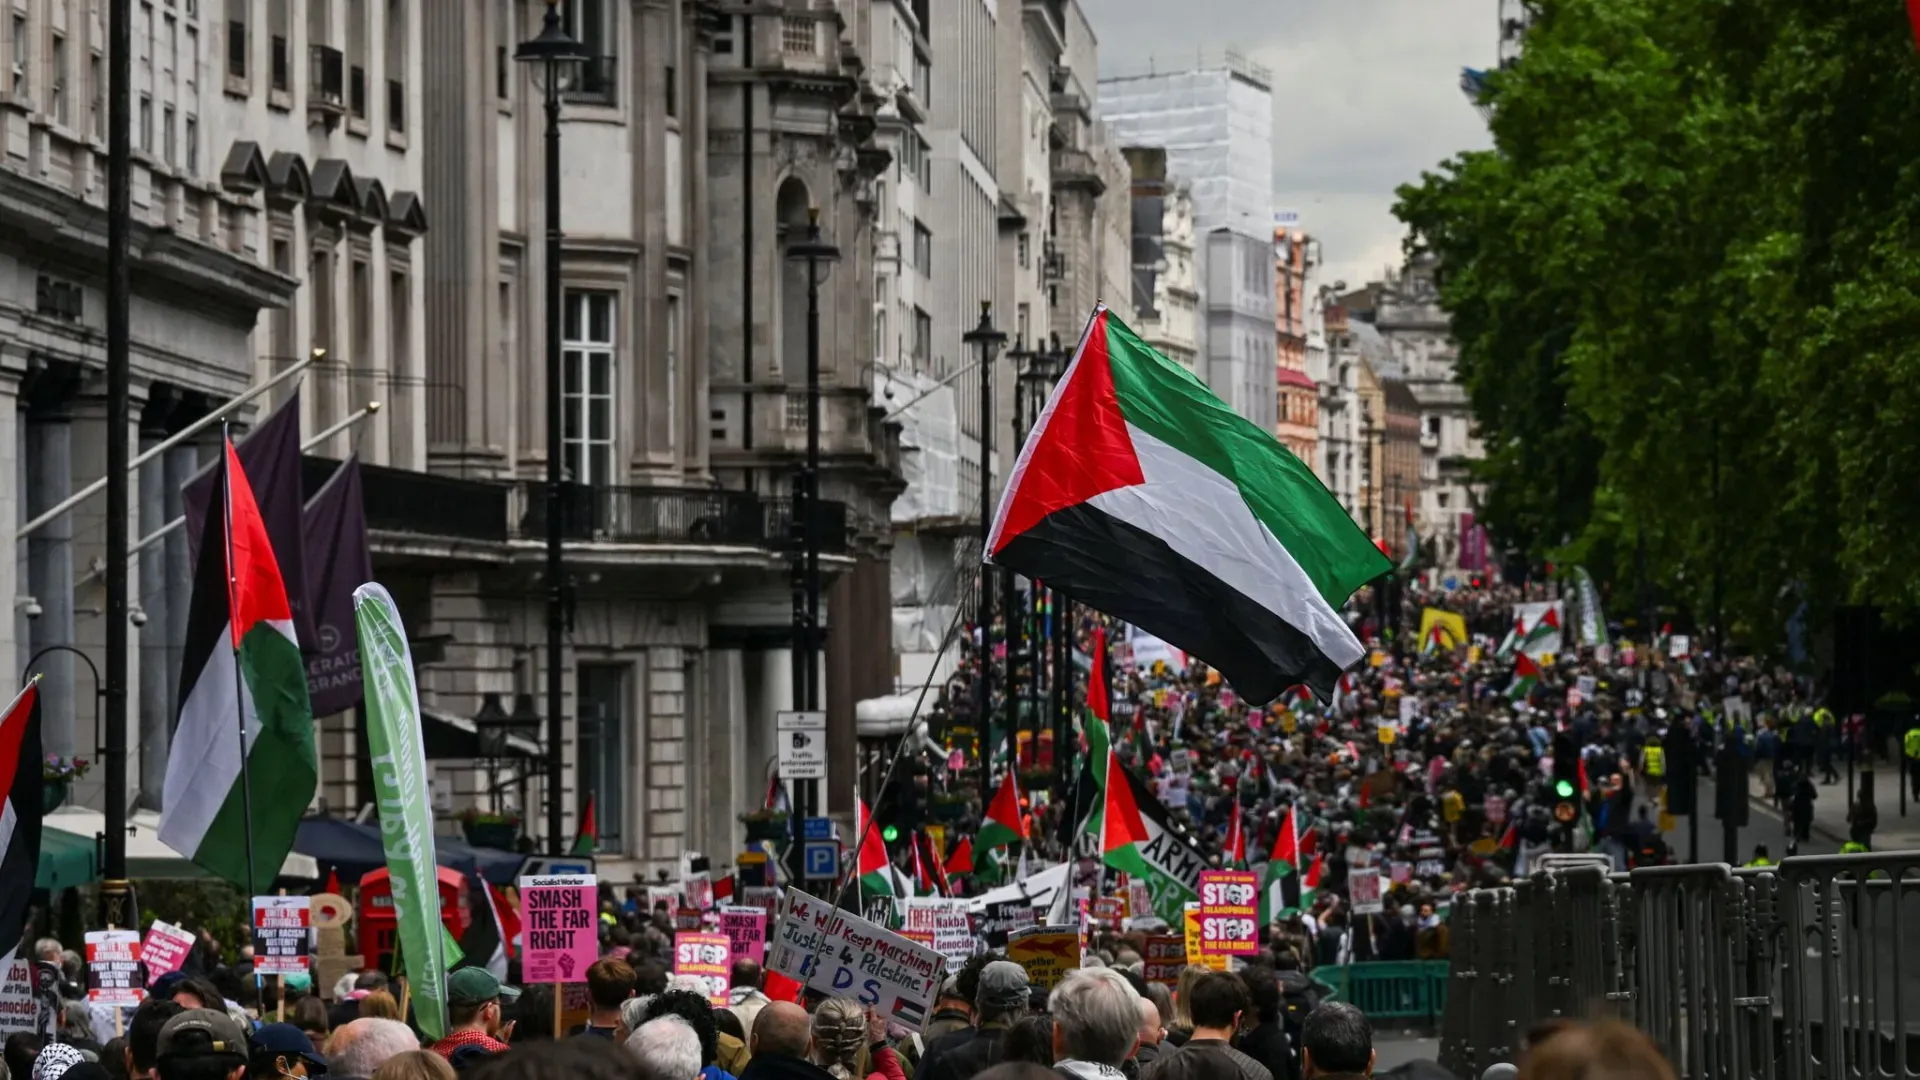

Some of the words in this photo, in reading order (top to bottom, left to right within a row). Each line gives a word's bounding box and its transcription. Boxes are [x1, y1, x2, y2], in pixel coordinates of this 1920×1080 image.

[792, 751, 813, 759] Traffic
[813, 850, 830, 871] P
[532, 878, 560, 886] Socialist
[561, 878, 585, 886] Worker
[528, 889, 582, 909] SMASH
[1203, 882, 1254, 906] STOP
[789, 896, 810, 922] We
[814, 909, 844, 936] Wll
[1203, 906, 1254, 914] ISLAMOPHOBIA
[528, 910, 558, 929] THE
[562, 909, 590, 928] FAR
[724, 915, 757, 928] SMASH
[936, 916, 966, 929] Nakba
[257, 928, 277, 938] FIGHT
[278, 928, 306, 938] RACISM
[1203, 917, 1255, 940] STOP
[530, 930, 576, 950] RIGHT
[743, 929, 761, 942] FAR
[265, 938, 298, 947] AUSTERITY
[731, 941, 751, 954] IGHT
[936, 939, 974, 950] Genocide
[1204, 941, 1218, 950] THE
[1218, 941, 1231, 950] FAR
[1232, 941, 1255, 950] RIGHT
[267, 946, 280, 955] AND
[281, 946, 297, 955] WAR
[678, 943, 728, 965] STOP
[838, 945, 854, 965] 4
[90, 963, 110, 972] FIGHT
[111, 961, 138, 971] RACISM
[15, 984, 30, 994] Plan
[831, 966, 854, 989] D
[858, 979, 881, 1005] S
